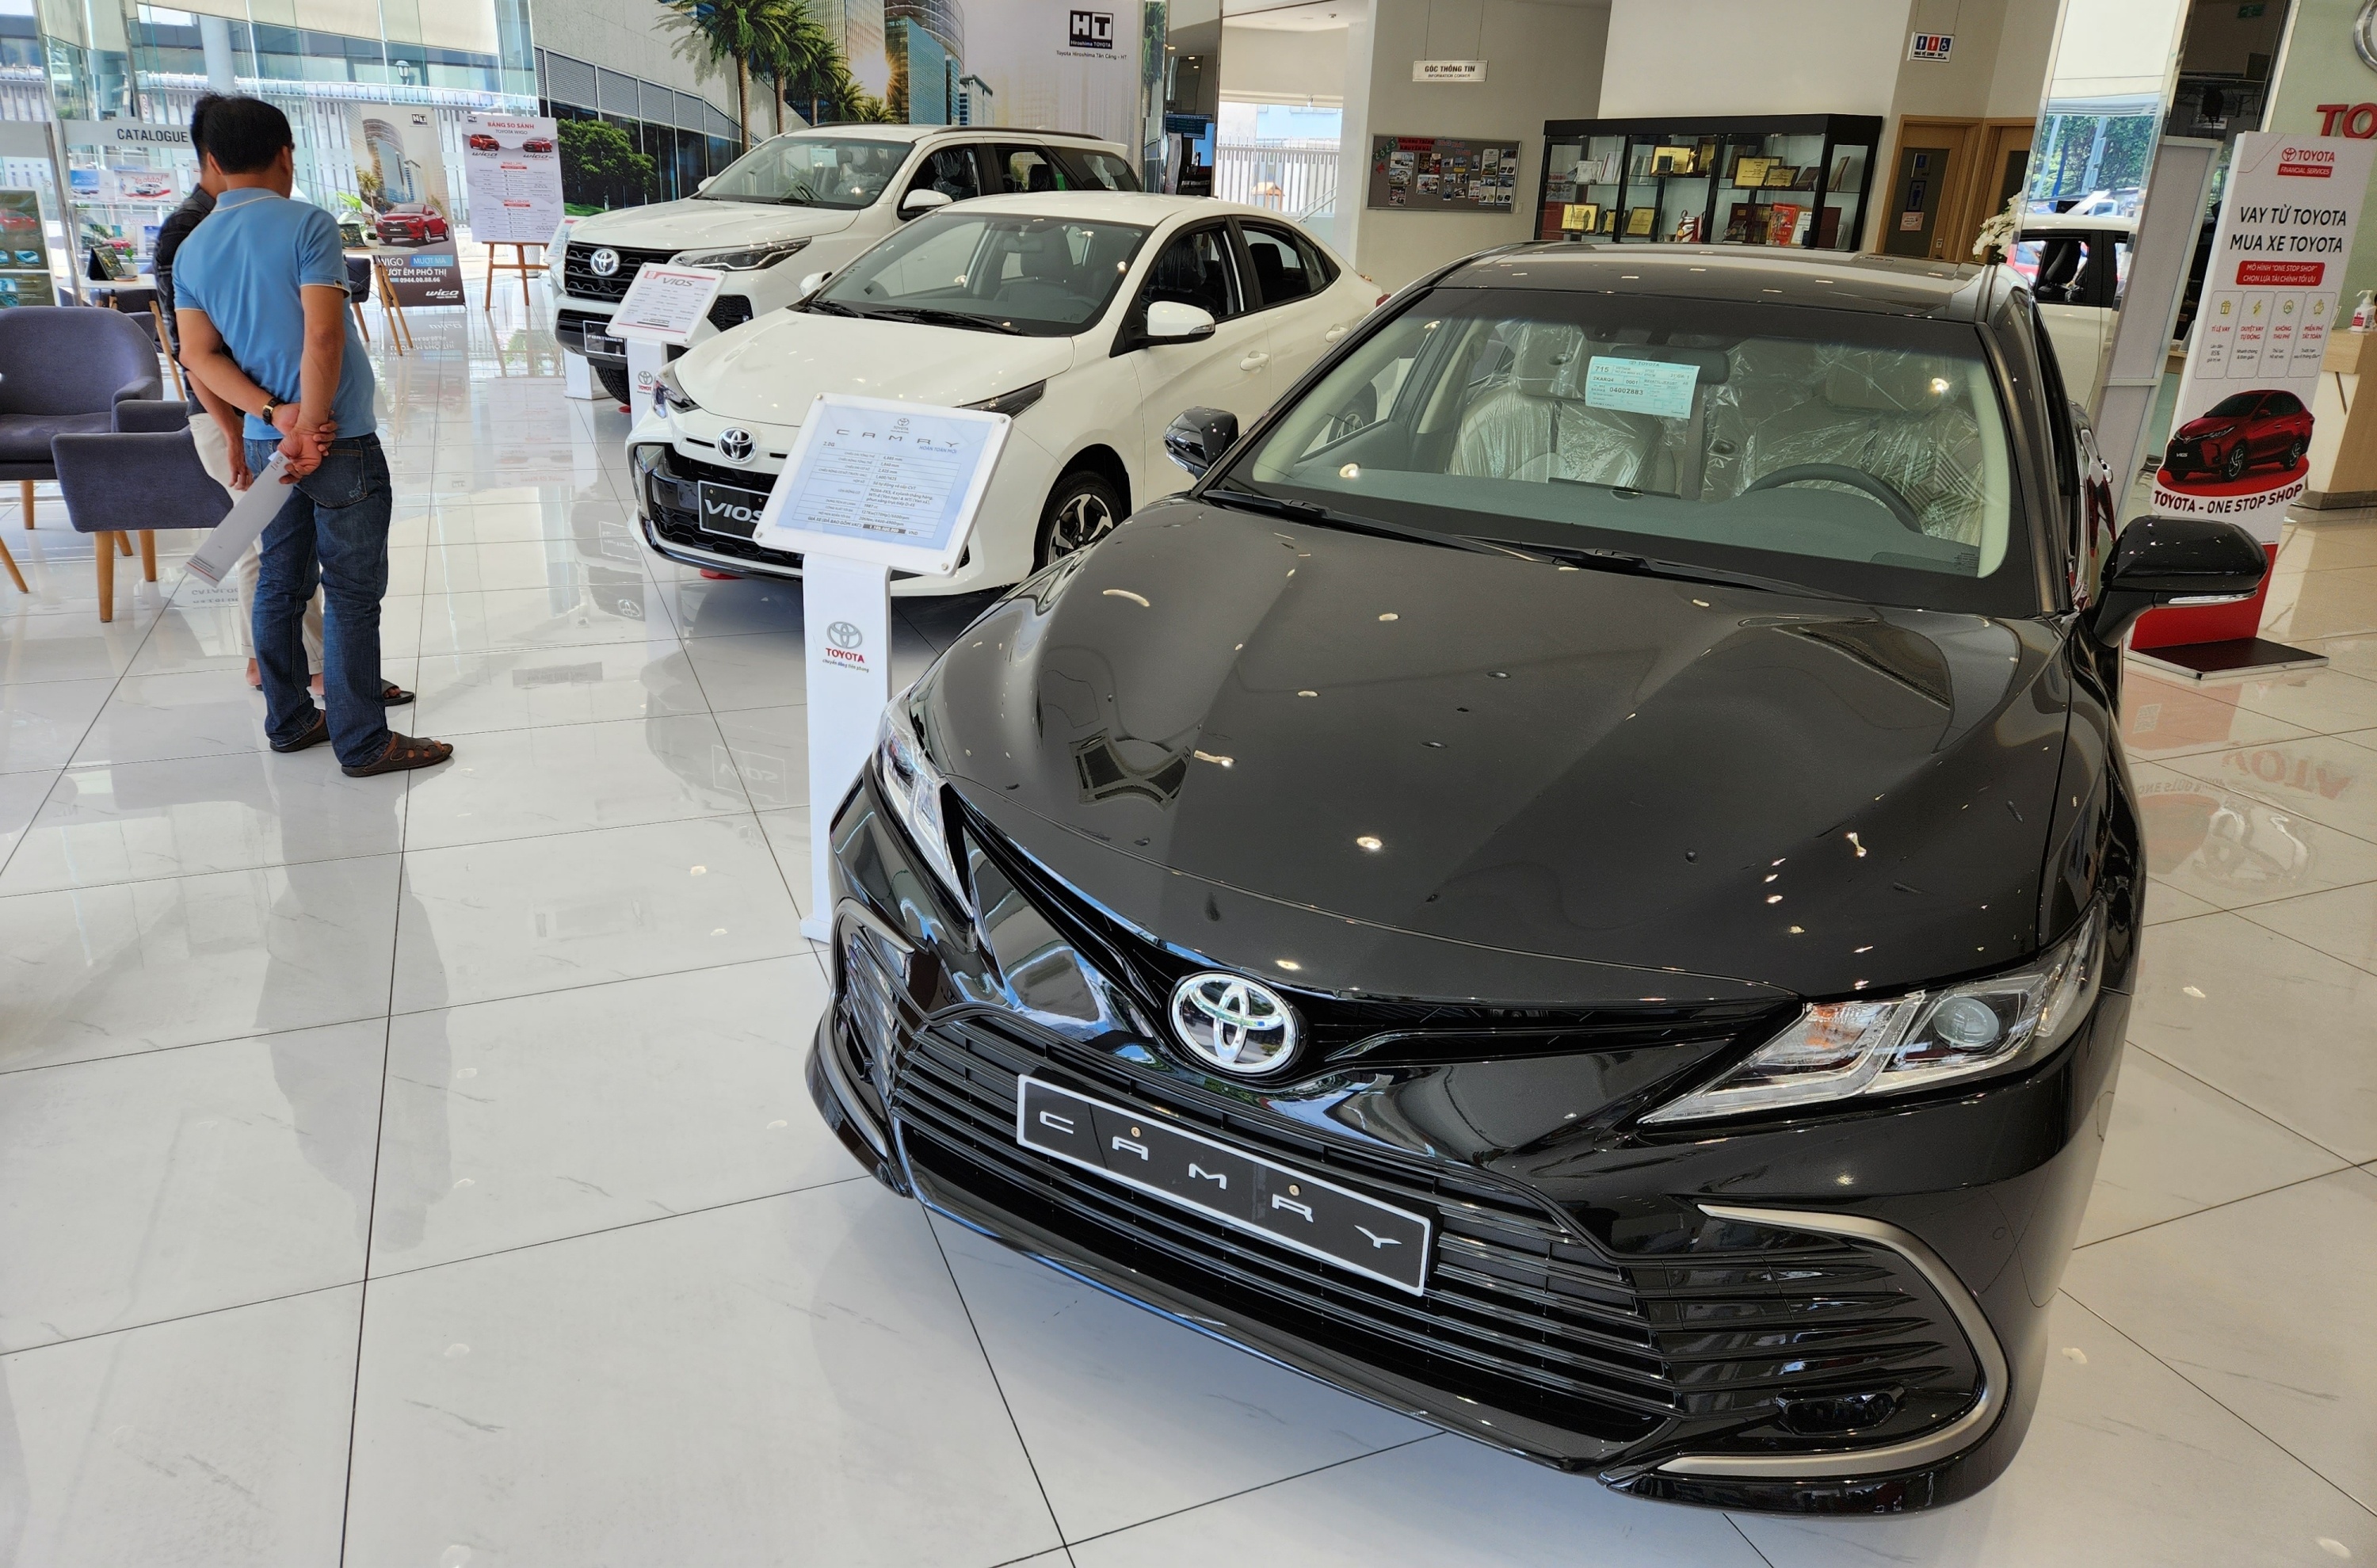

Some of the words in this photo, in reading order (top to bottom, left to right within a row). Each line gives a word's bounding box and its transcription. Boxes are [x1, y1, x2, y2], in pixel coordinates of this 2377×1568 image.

[1072, 13, 1110, 36] HT
[117, 128, 189, 143] CATALOGUE
[2299, 150, 2334, 162] TOYOTA
[2240, 206, 2268, 223] VAY
[2271, 204, 2291, 224] TỪ
[2293, 208, 2346, 226] TOYOTA
[2230, 234, 2262, 250] MUA
[2266, 235, 2286, 251] XE
[2290, 236, 2342, 253] TOYOTA
[403, 267, 414, 277] ÊM
[416, 267, 433, 277] PHỐ
[434, 269, 447, 277] THỊ
[2246, 262, 2257, 271] MÔ
[2257, 262, 2272, 271] HÌNH
[662, 277, 695, 287] VIOS
[587, 334, 624, 343] FORTUNER
[1609, 387, 1643, 395] 04002883
[837, 429, 960, 448] CAMRY
[2154, 490, 2196, 513] TOYOTA
[2207, 500, 2233, 513] ONE
[2234, 494, 2266, 513] STOP
[2268, 483, 2303, 505] SHOP
[704, 498, 763, 524] VIOS
[826, 647, 864, 663] TOYOTA
[1039, 1110, 1402, 1249] CAMRY
